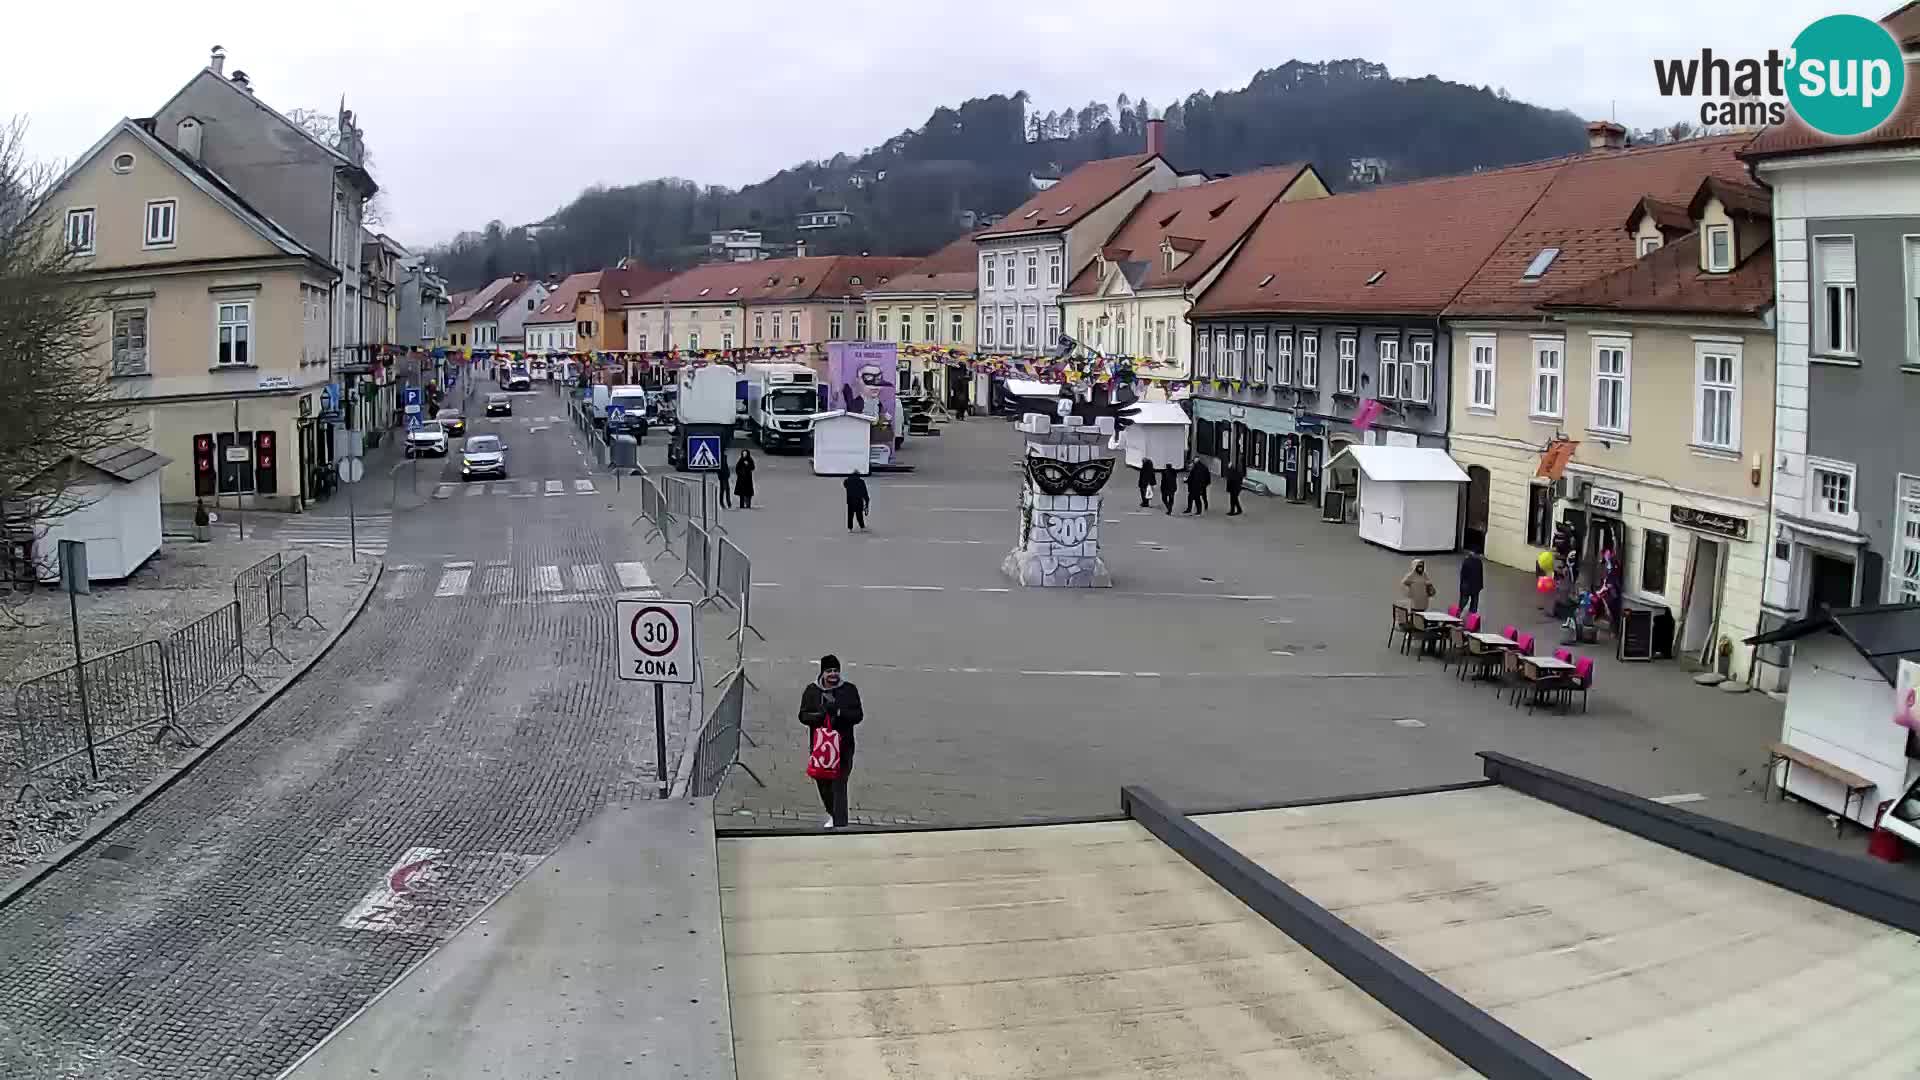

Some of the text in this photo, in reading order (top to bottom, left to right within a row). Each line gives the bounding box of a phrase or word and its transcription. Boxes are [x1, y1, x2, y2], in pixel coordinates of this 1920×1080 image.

[409, 392, 416, 402] P
[1047, 516, 1087, 545] 200
[644, 622, 667, 643] 30
[634, 660, 678, 676] ZONA
